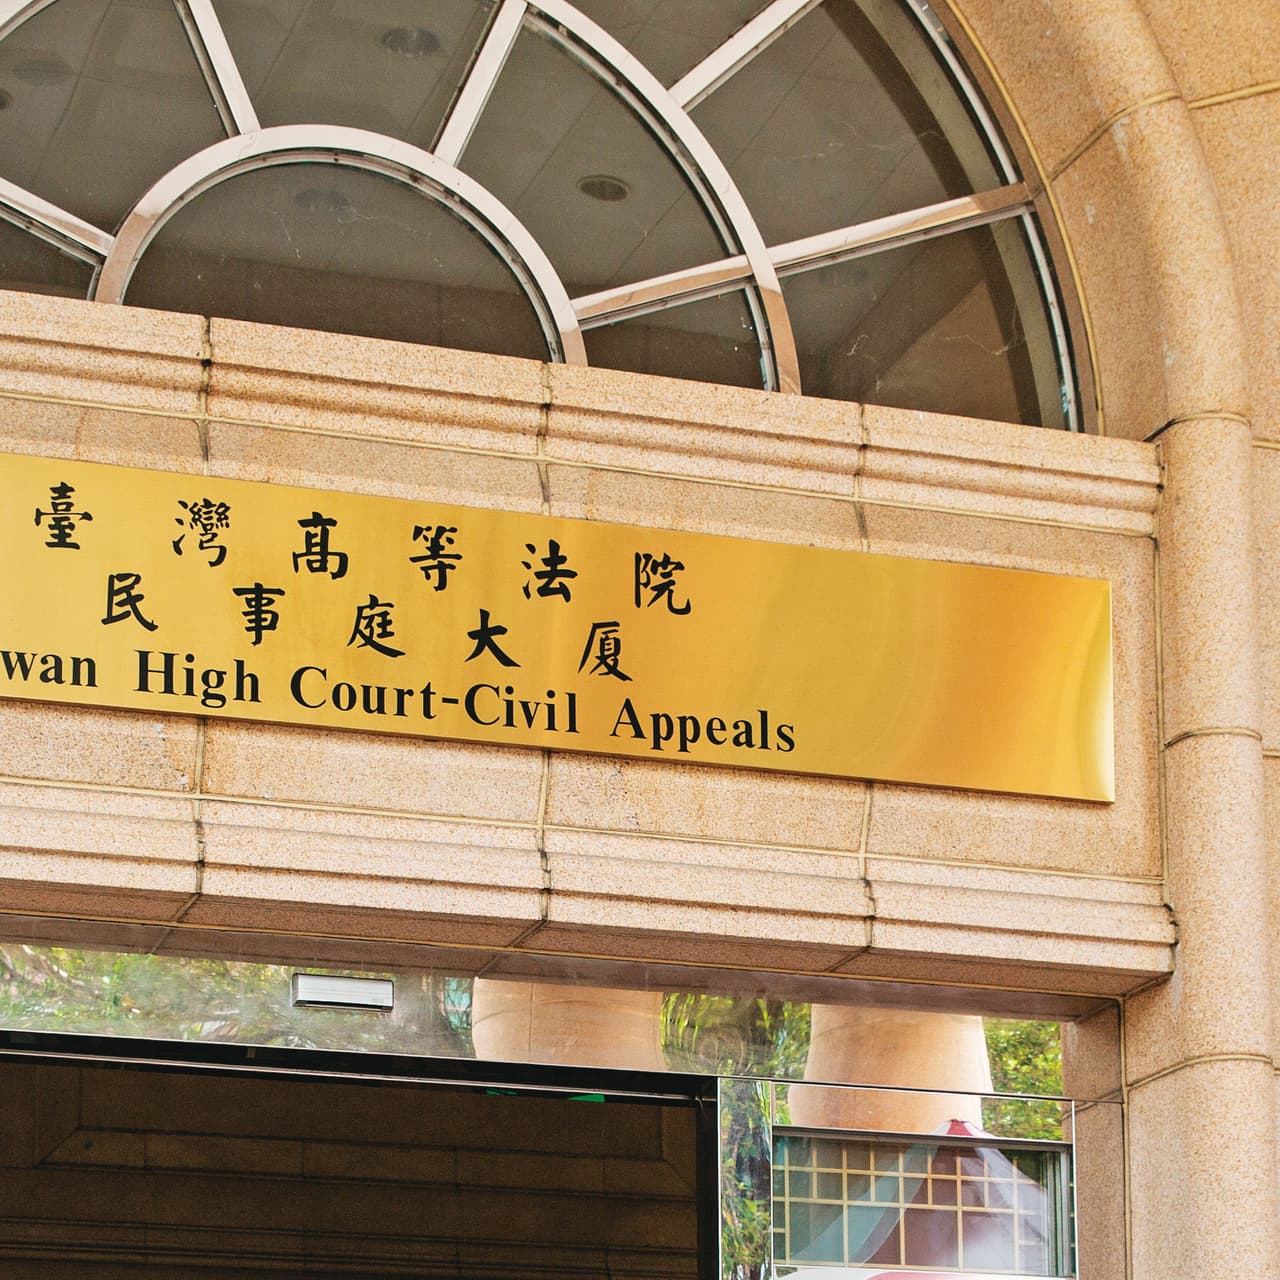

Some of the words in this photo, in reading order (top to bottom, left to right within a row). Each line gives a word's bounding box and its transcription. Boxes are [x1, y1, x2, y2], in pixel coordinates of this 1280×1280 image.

[32, 482, 692, 615] 臺灣高等法院
[135, 649, 261, 708] High
[290, 665, 580, 736] Court-Civil
[611, 697, 797, 763] Appeals
